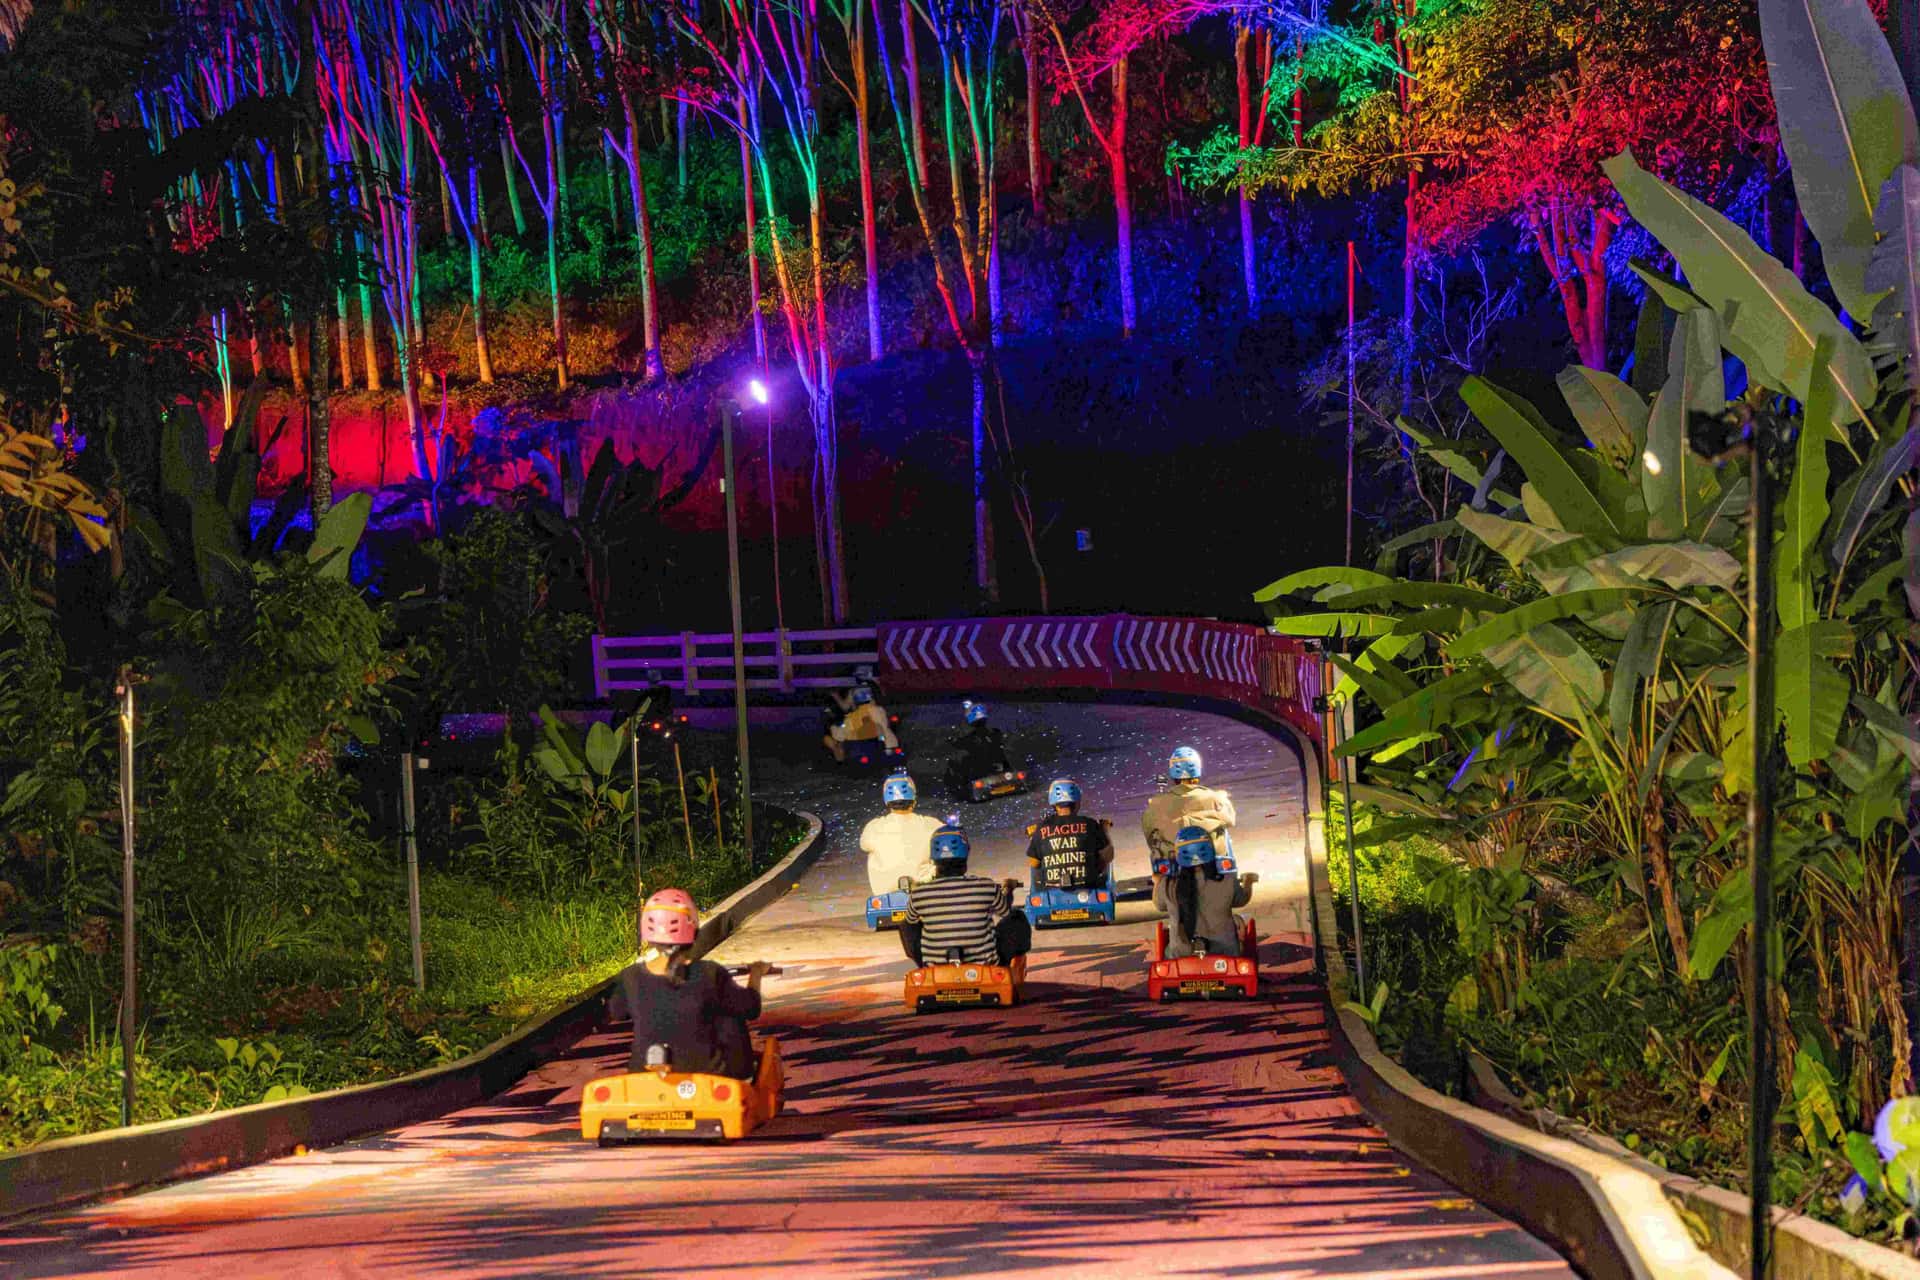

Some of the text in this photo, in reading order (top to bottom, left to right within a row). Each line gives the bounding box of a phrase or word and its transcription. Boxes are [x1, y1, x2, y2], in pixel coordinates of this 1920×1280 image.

[1040, 823, 1087, 840] PLAGUE
[1049, 837, 1078, 850] WAR
[1043, 851, 1087, 868] FAMINE
[1046, 865, 1086, 881] DEATH
